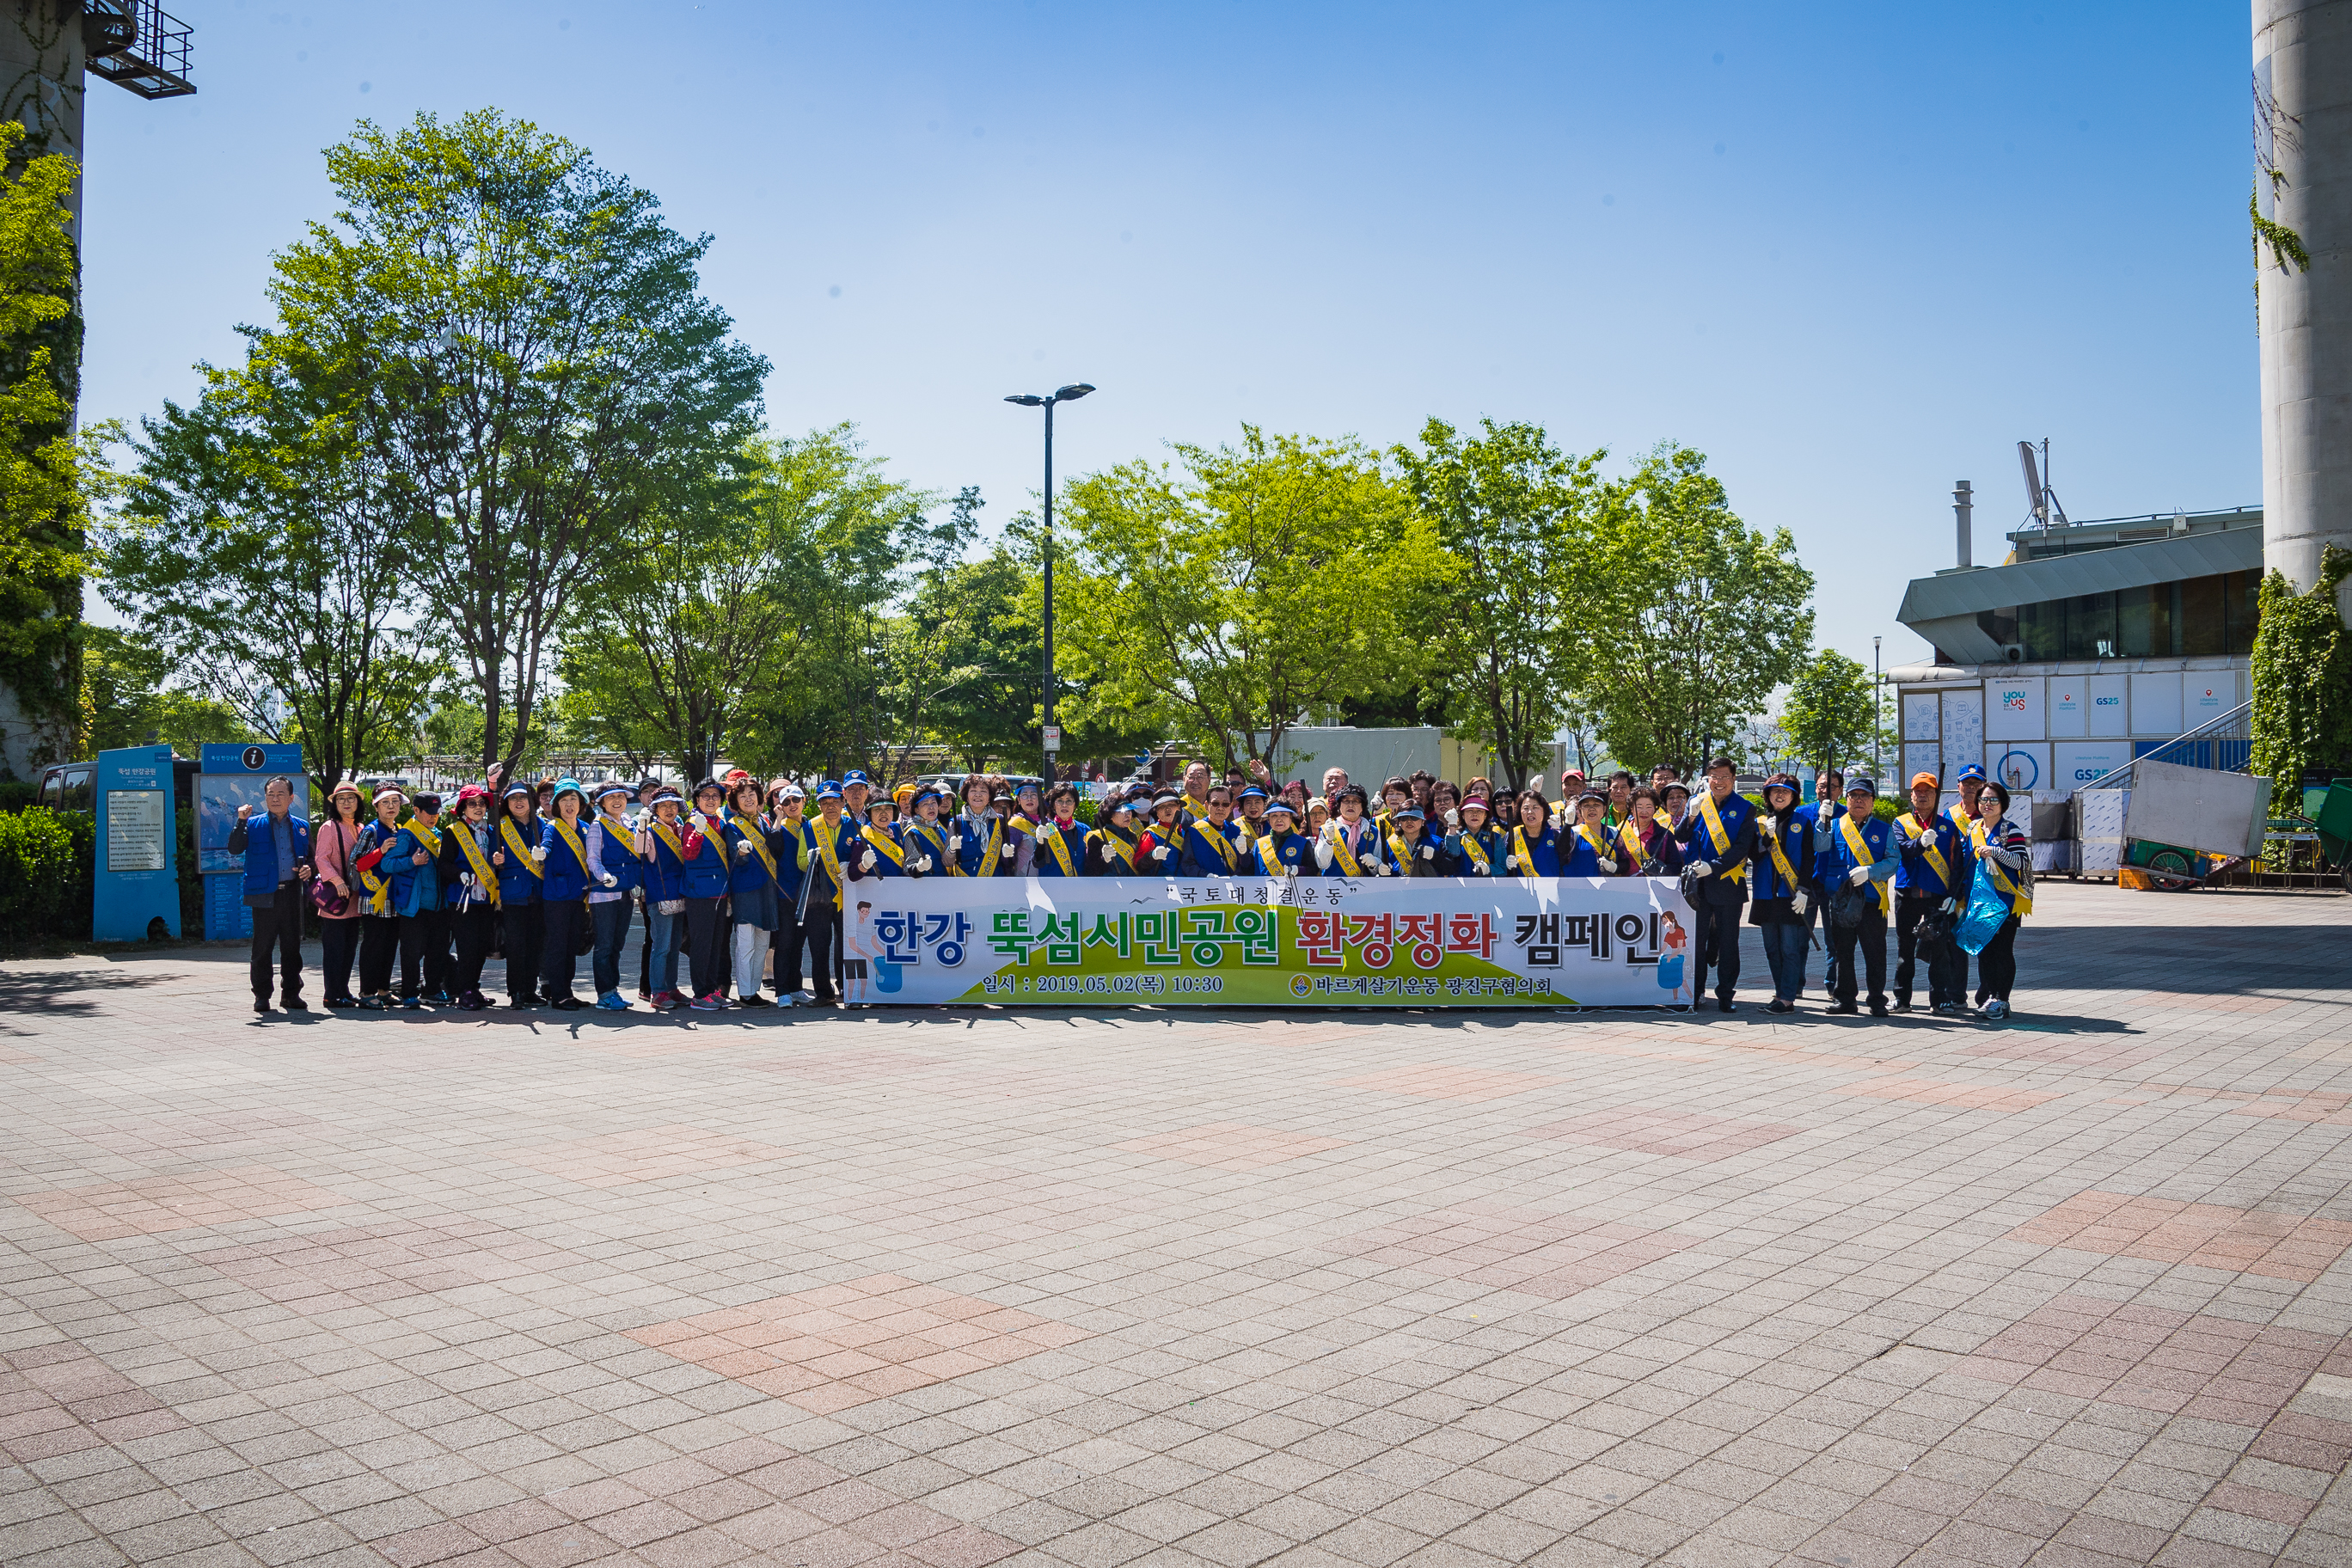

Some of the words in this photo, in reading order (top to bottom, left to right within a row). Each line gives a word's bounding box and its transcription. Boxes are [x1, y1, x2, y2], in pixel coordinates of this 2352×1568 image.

[616, 827, 628, 840] 산을
[926, 830, 938, 841] 산을
[457, 831, 483, 866] 바르게살기운동
[815, 827, 835, 863] 바르게살기운동
[989, 835, 1001, 856] 깨끗하게
[1050, 836, 1062, 848] 산을
[1056, 847, 1068, 861] 항상
[1515, 841, 1525, 853] 산을
[1847, 830, 1871, 866] 바르게살기운동
[981, 854, 995, 876] 이용합시
[1332, 840, 1344, 853] 항상
[1338, 850, 1356, 873] 깨끗하게
[360, 870, 380, 891] 이용합시
[873, 910, 974, 967] 한강
[986, 909, 1279, 967] 뚝섬시민공원
[1295, 911, 1499, 969] 환경정화
[1515, 911, 1661, 967] 캠페인
[983, 975, 1016, 994] 일시
[1037, 974, 1166, 995] 2019.05.02(목)
[1173, 975, 1223, 994] 10:30
[1315, 976, 1438, 995] 바르게살기운동
[1445, 976, 1553, 996] 광진구협의회
